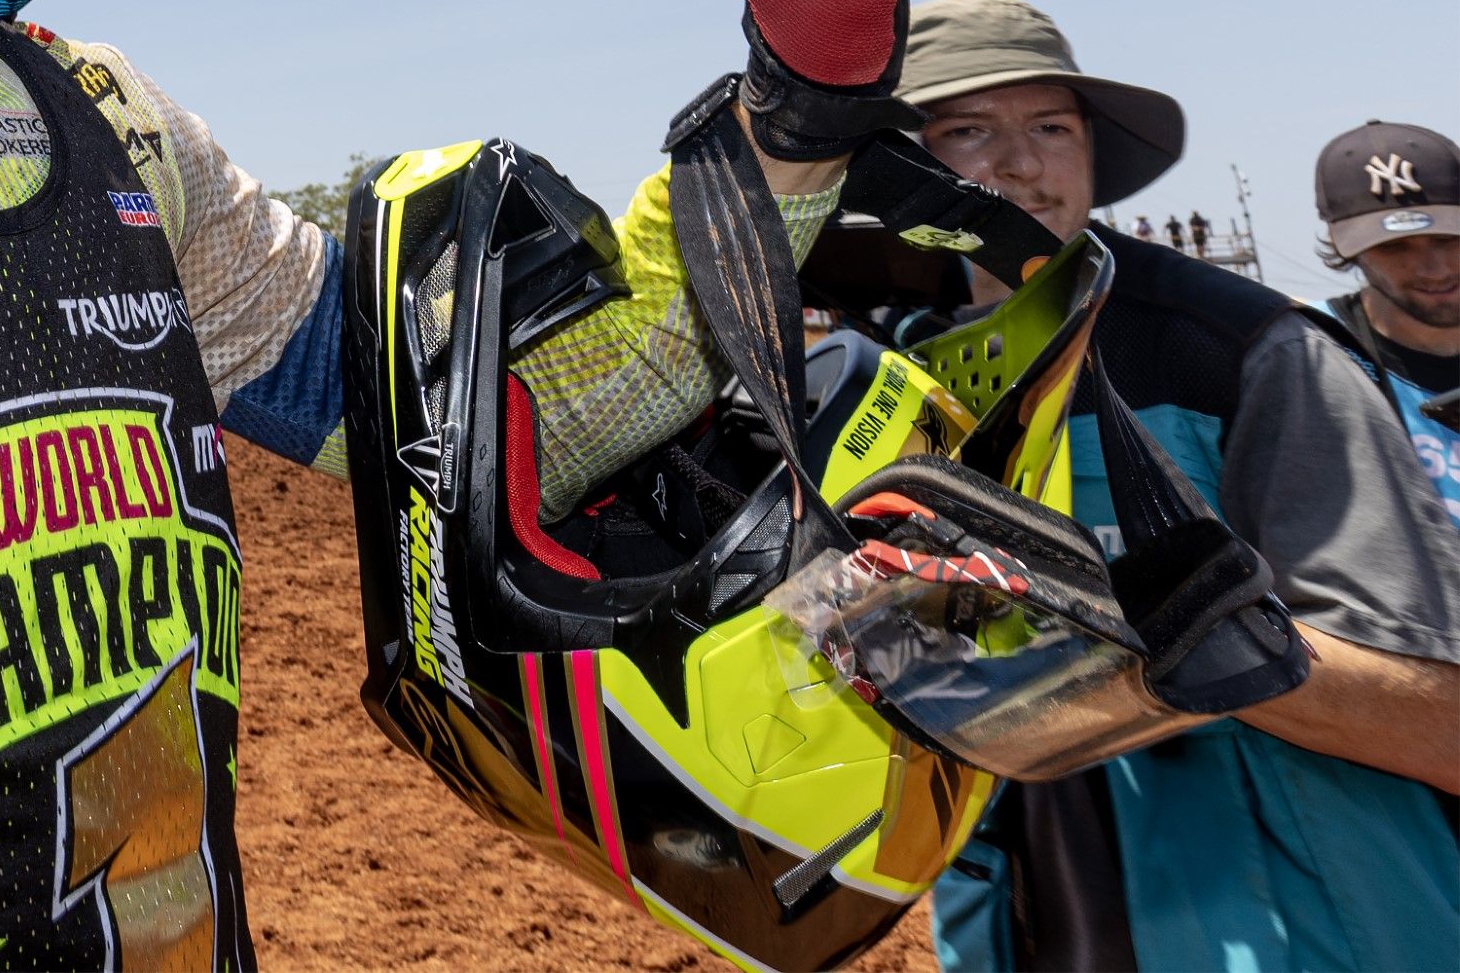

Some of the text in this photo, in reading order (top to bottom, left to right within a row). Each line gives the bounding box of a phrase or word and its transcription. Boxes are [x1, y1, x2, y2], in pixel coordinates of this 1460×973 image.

[107, 191, 157, 213] PART
[872, 390, 898, 420] ONE
[842, 412, 886, 460] VISION
[441, 442, 454, 490] TRIUMPH
[399, 509, 414, 644] FACTORY TEAM
[410, 485, 445, 689] RACING
[430, 508, 475, 710] TRIUMPH
